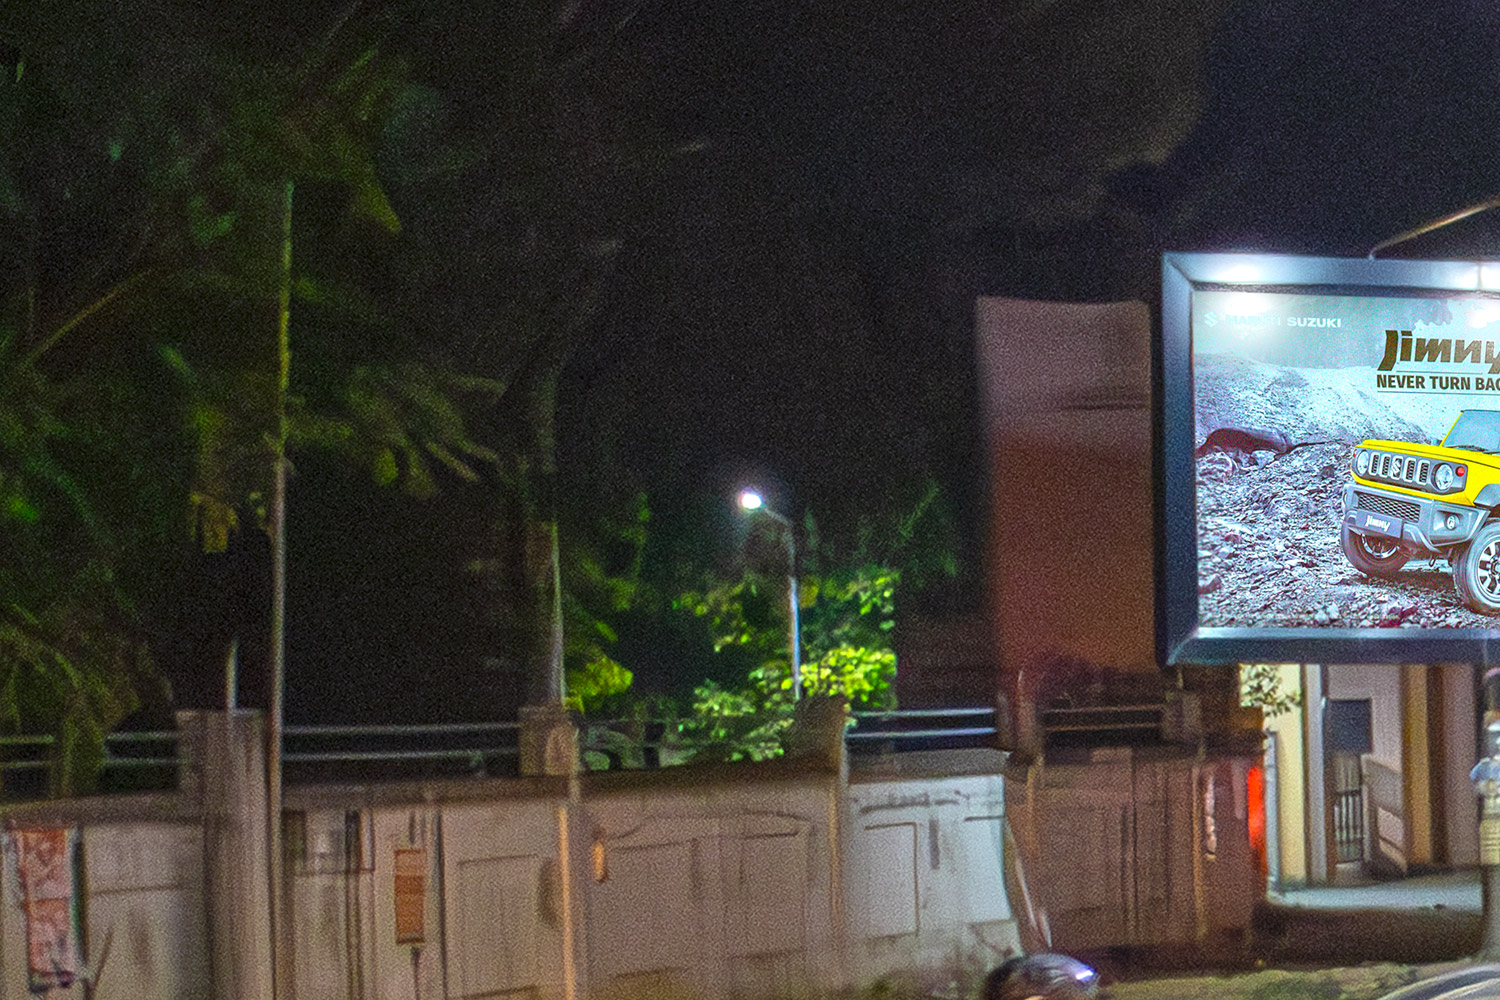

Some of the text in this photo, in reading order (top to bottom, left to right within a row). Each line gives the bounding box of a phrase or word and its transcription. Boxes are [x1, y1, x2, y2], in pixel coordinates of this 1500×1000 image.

[1286, 316, 1342, 328] SUZUKI
[1376, 374, 1425, 389] NEVER
[1429, 375, 1471, 390] TURN
